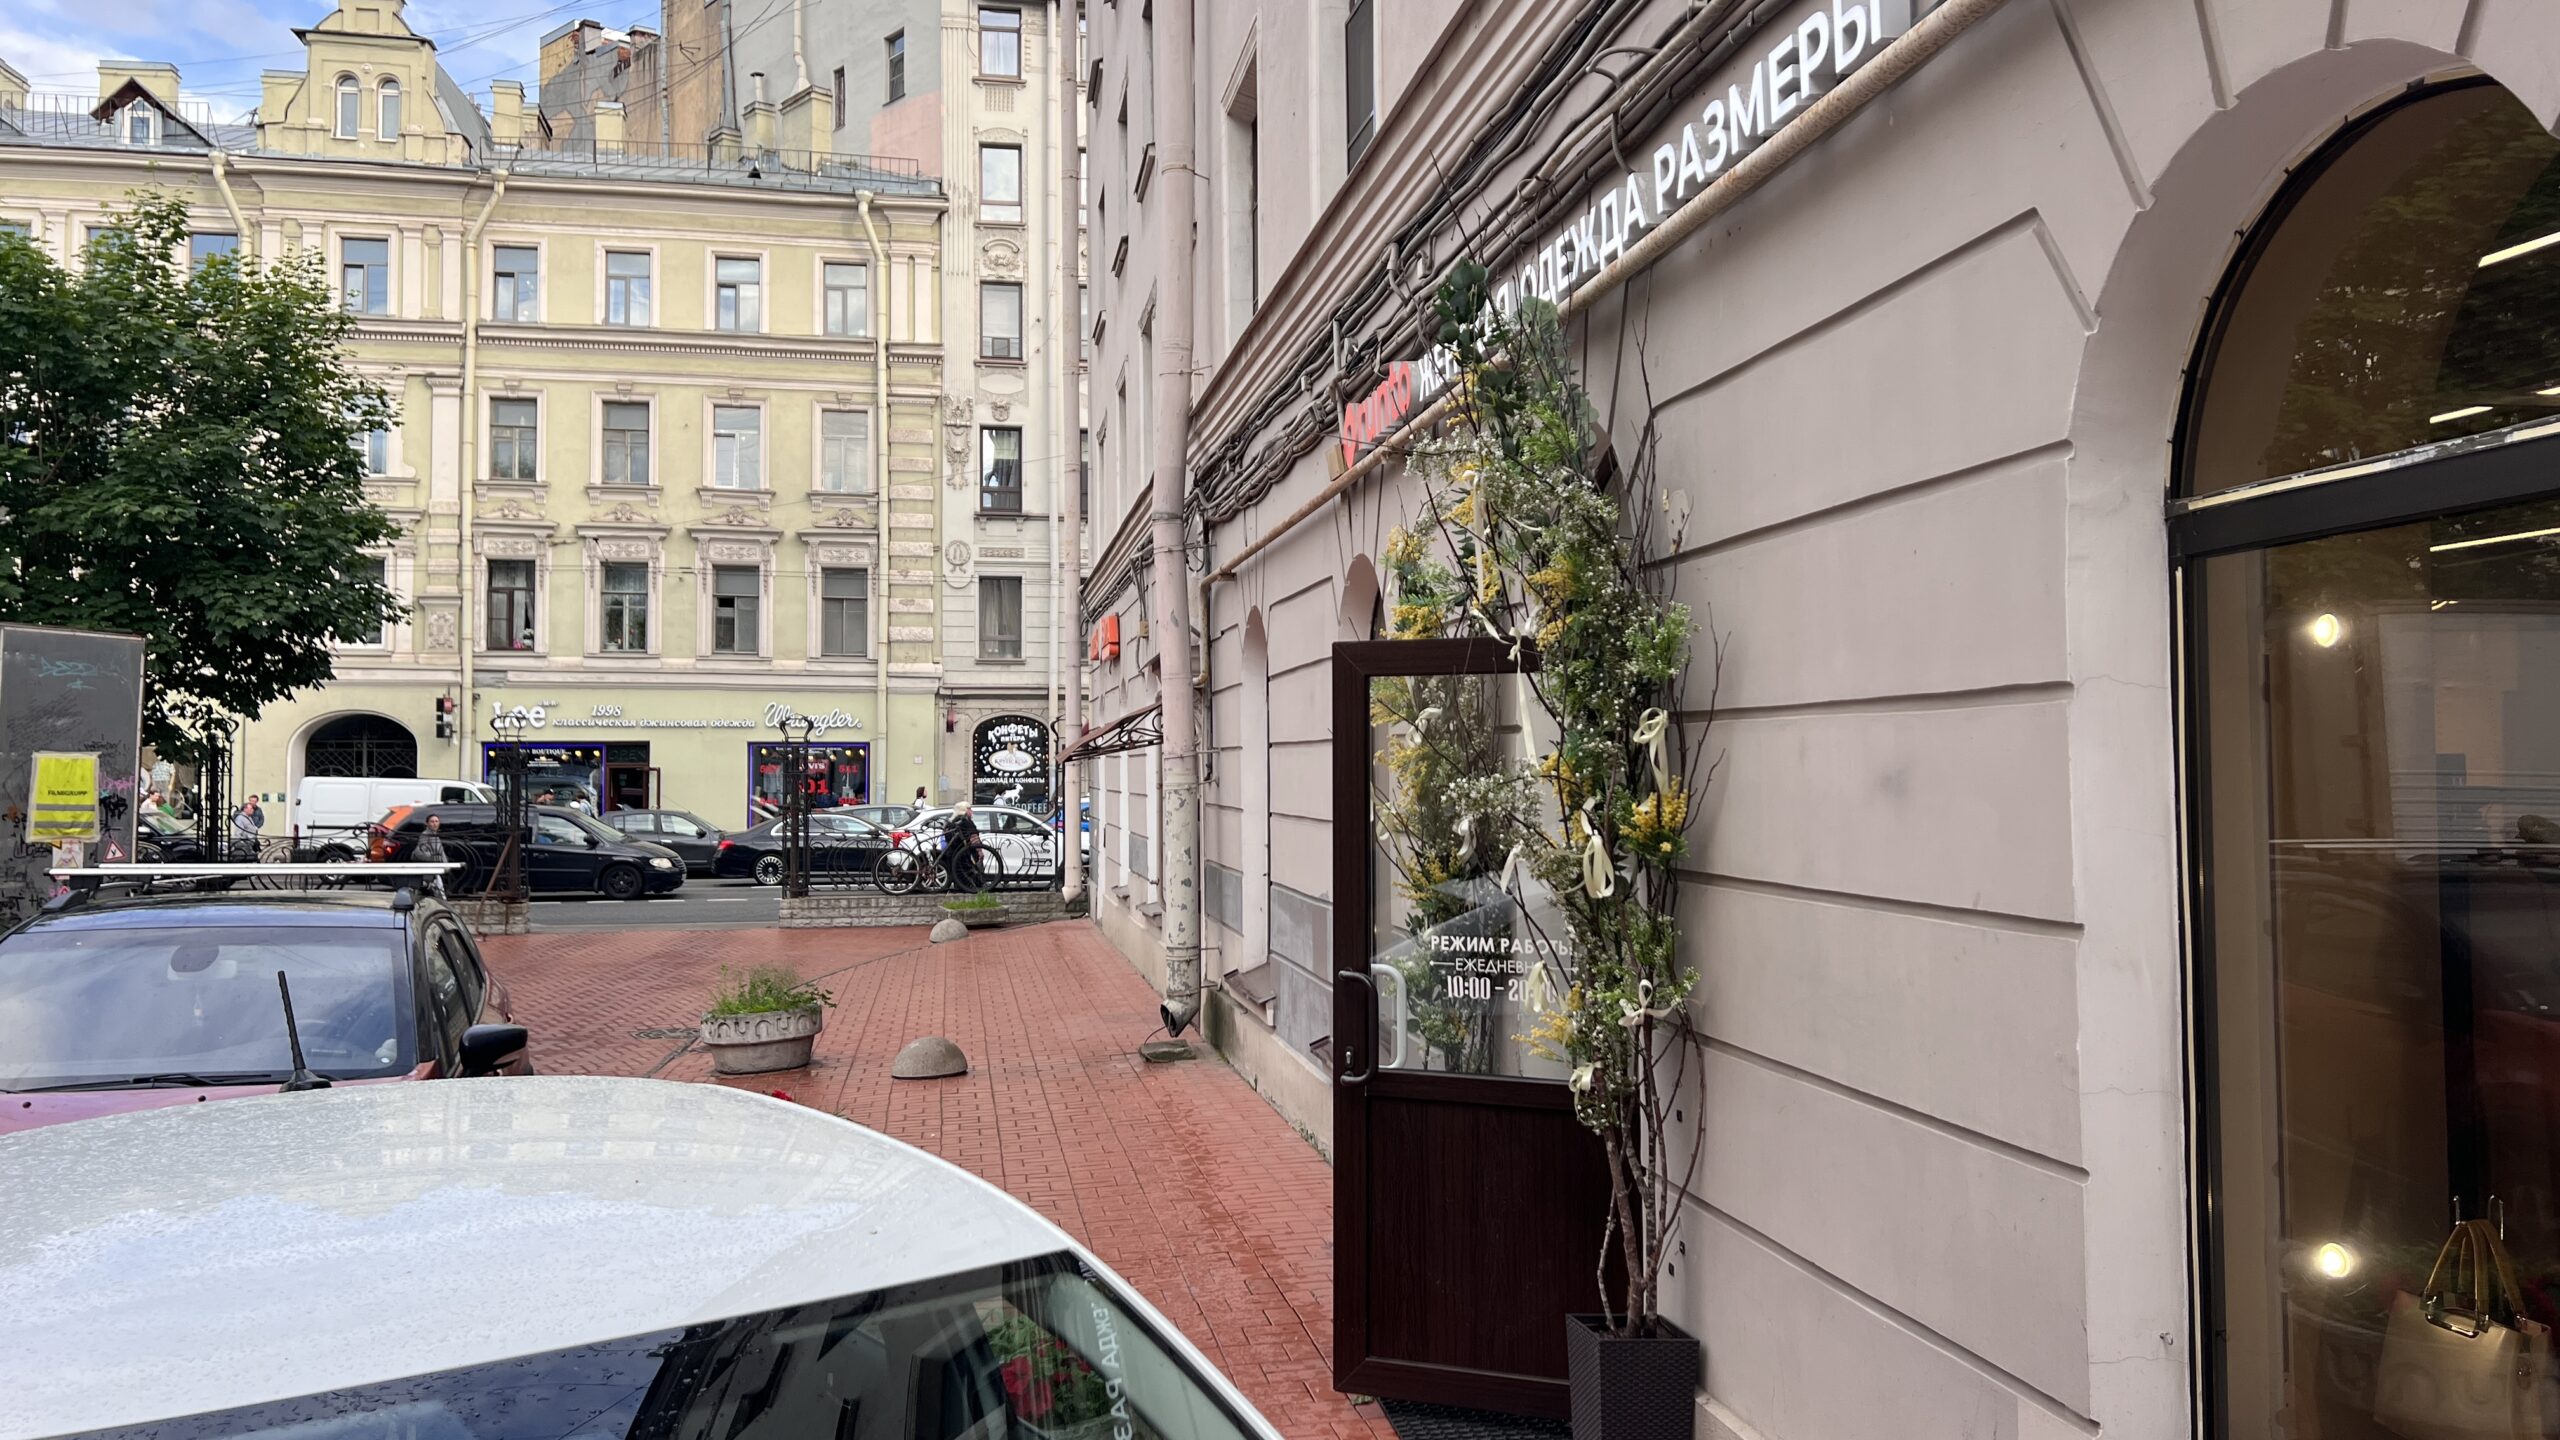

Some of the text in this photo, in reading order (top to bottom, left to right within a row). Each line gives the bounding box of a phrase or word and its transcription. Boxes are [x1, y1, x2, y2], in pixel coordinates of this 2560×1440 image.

[1654, 0, 1882, 213] РАЗМЕРЫ
[591, 704, 622, 717] 1998
[764, 702, 859, 736] Wrangler
[552, 718, 756, 728] классическая джинсовая одежда
[988, 723, 1038, 745] КОНФЕТЫ
[1431, 935, 1495, 953] РЕЖИМ
[1455, 957, 1541, 974] ЕЖЕДНЕВН
[1447, 976, 1491, 999] 10:00
